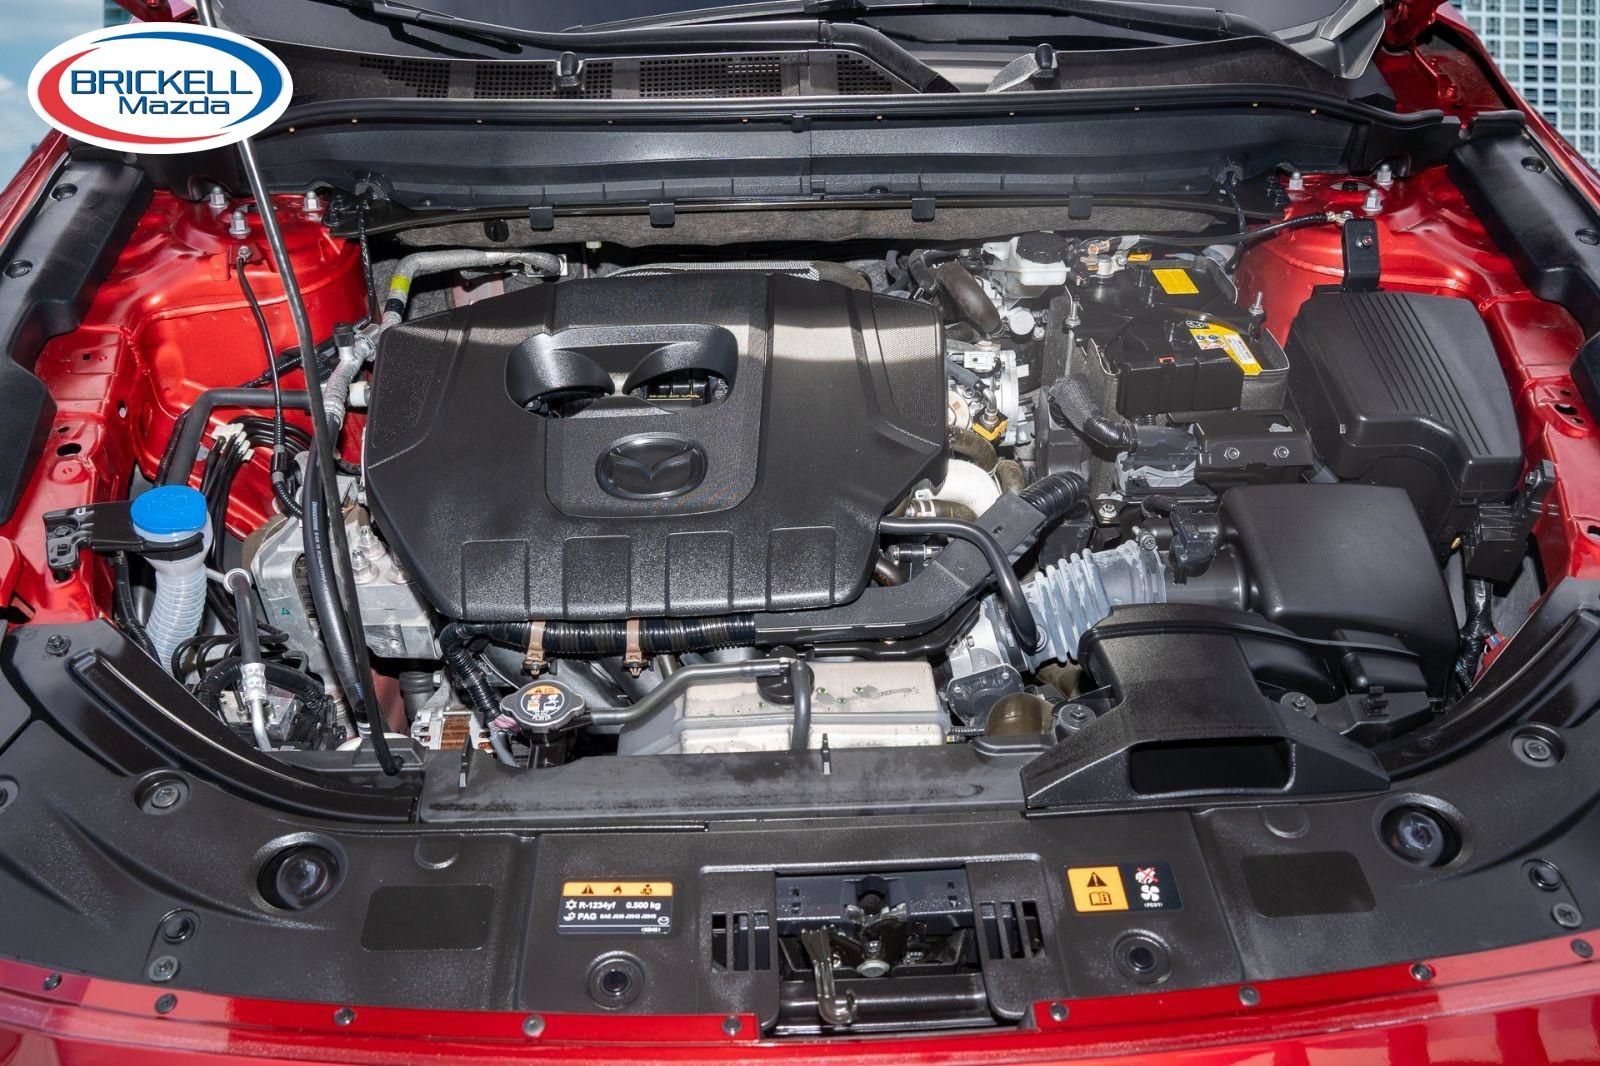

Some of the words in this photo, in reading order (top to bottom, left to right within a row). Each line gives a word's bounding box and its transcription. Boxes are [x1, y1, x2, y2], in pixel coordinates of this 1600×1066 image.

[578, 901, 616, 910] R-1234yf
[625, 901, 649, 909] 0.500
[650, 901, 661, 910] kg
[577, 912, 597, 921] PAG
